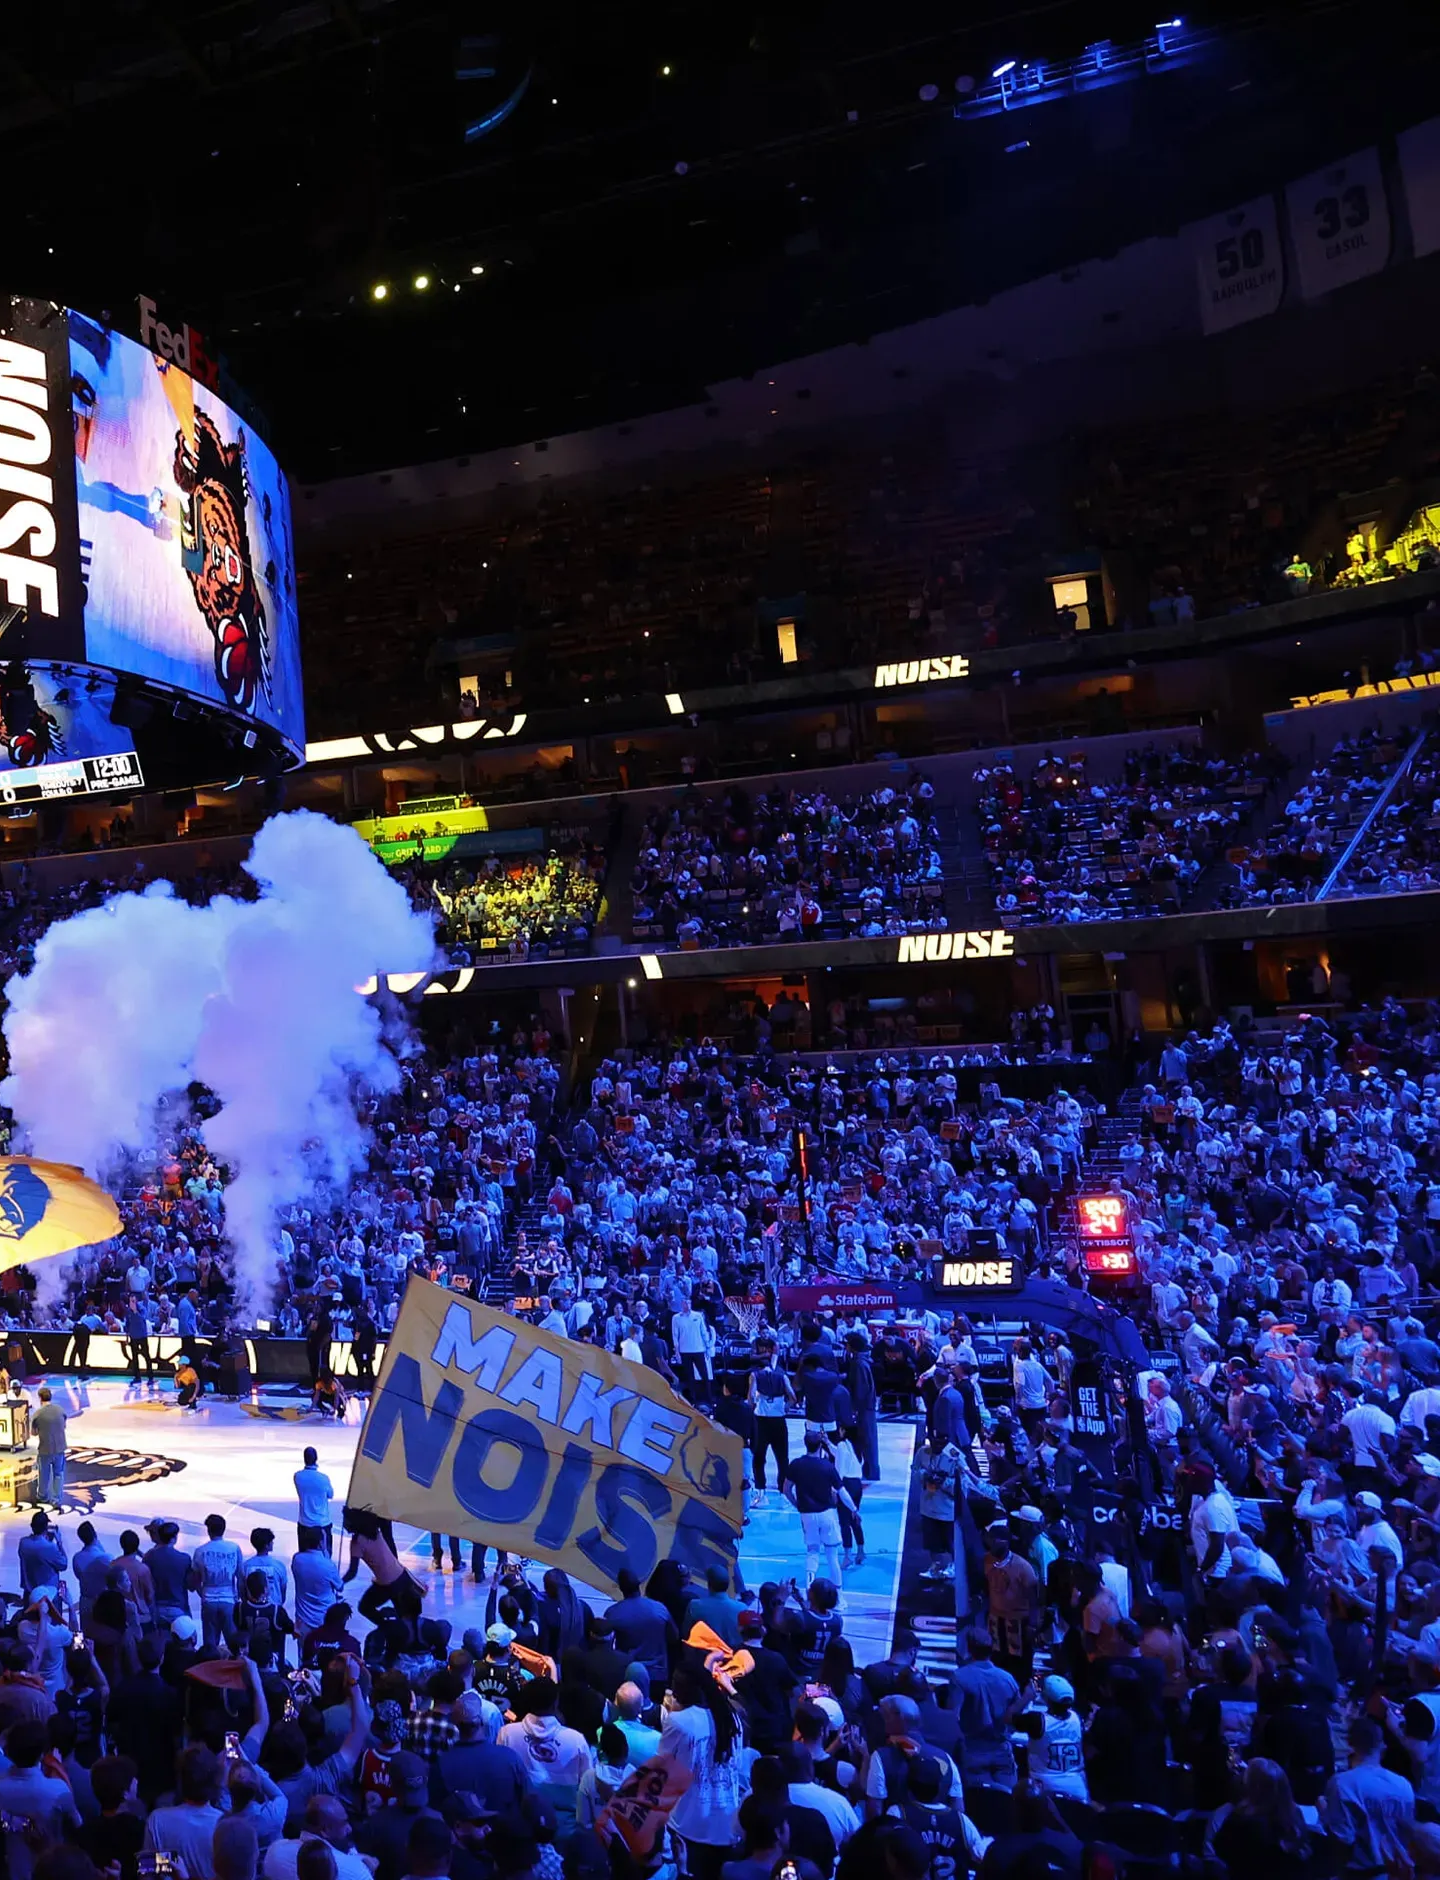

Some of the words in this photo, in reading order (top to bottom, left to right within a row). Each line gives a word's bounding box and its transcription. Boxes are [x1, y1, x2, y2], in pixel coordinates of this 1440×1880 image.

[1314, 185, 1370, 239] 33
[1215, 228, 1264, 279] 50
[92, 756, 132, 779] 12:00
[943, 1262, 1012, 1286] NOISE
[431, 1301, 692, 1475] MAKE
[1078, 1387, 1097, 1401] GET
[1080, 1402, 1100, 1417] THE
